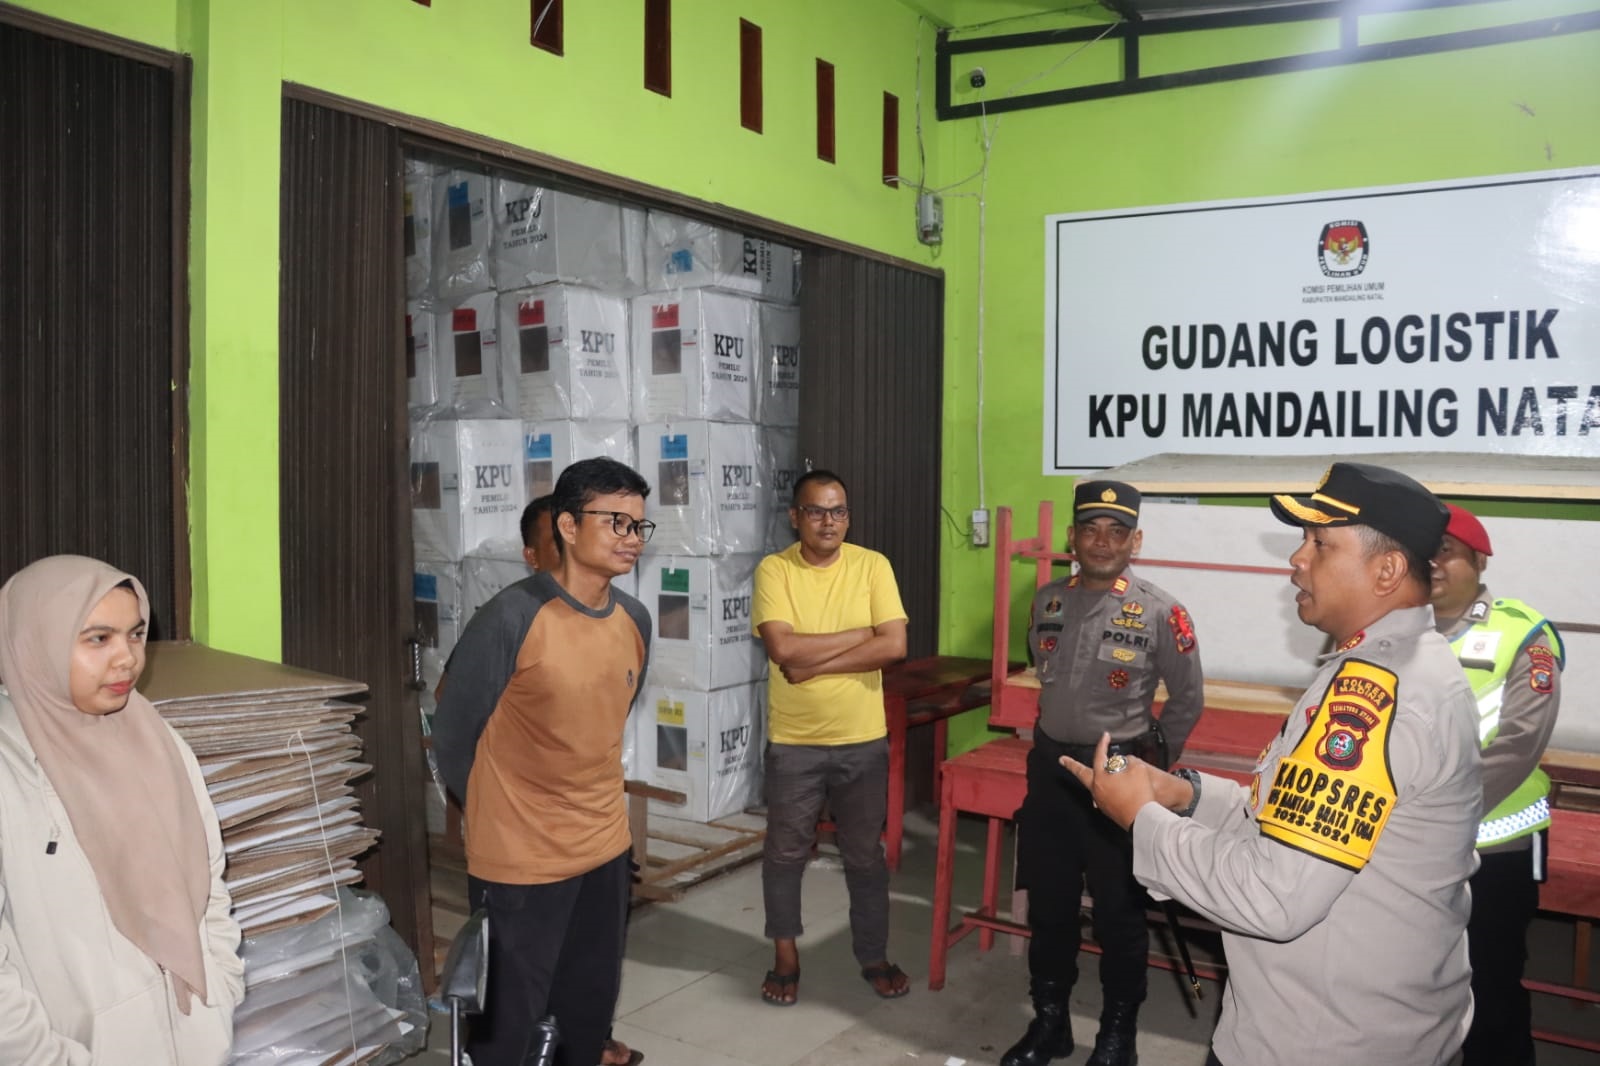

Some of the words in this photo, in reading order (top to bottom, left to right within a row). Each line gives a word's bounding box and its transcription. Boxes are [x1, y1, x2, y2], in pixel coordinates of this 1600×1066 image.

[505, 196, 542, 223] KPU
[1302, 286, 1325, 294] KOMISI
[1326, 283, 1362, 292] PEMILIHAN
[1363, 281, 1385, 291] UMUM
[580, 329, 615, 354] KPU
[713, 333, 744, 359] KPU
[1141, 319, 1318, 371] GUDANG
[1335, 309, 1560, 365] LOGISTIK
[1088, 393, 1167, 439] KPU
[1182, 388, 1459, 438] MANDAILING
[475, 463, 512, 489] KPU
[722, 464, 753, 488] KPU
[473, 505, 499, 515] TAHUN
[722, 596, 751, 620] KPU
[1102, 630, 1149, 649] POLRI
[1339, 686, 1382, 707] MADINA
[1342, 678, 1387, 699] POLRES
[720, 725, 750, 754] KPU
[1273, 761, 1388, 824] KAOPSRES
[1272, 806, 1351, 846] 2023-2024
[1315, 803, 1350, 831] BRATA
[1350, 817, 1376, 842] TOBA
